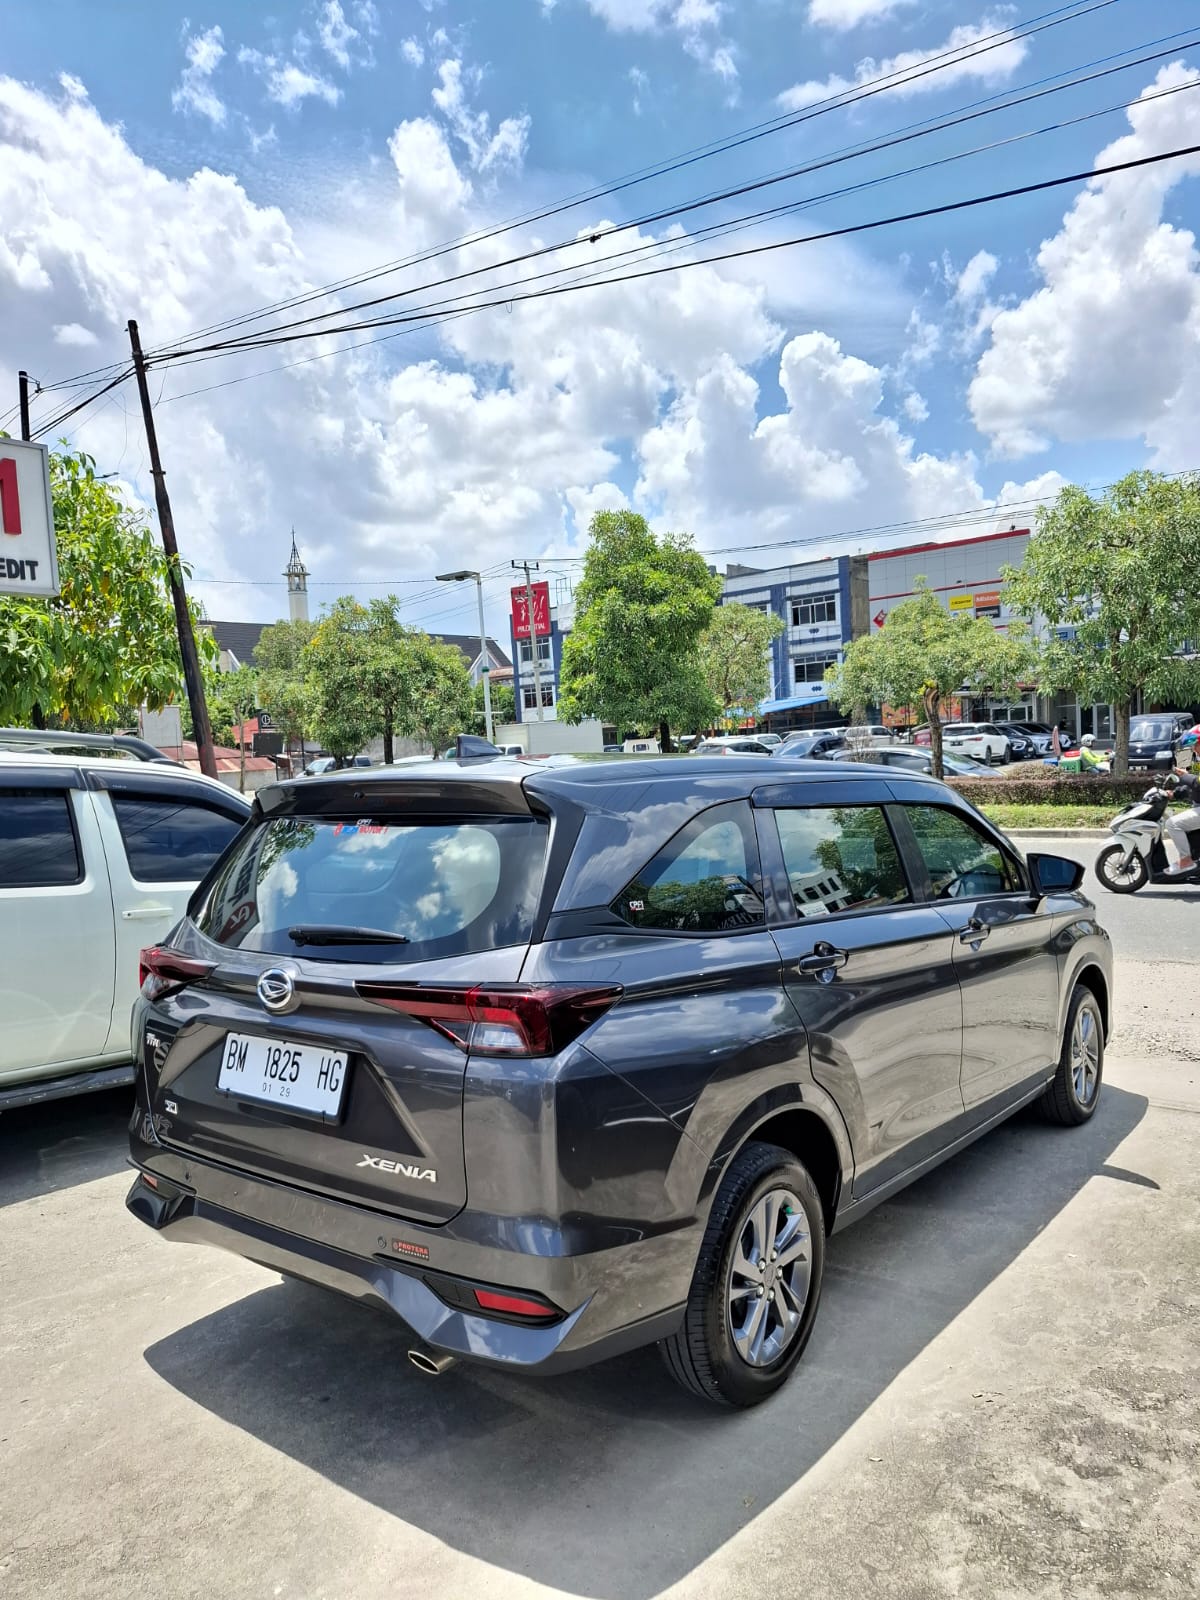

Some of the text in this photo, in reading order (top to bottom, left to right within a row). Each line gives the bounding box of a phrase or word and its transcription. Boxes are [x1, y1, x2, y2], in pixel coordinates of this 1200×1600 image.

[226, 1039, 342, 1092] BM 1825 HG
[262, 1082, 291, 1097] 01 29
[356, 1154, 437, 1183] XENIA
